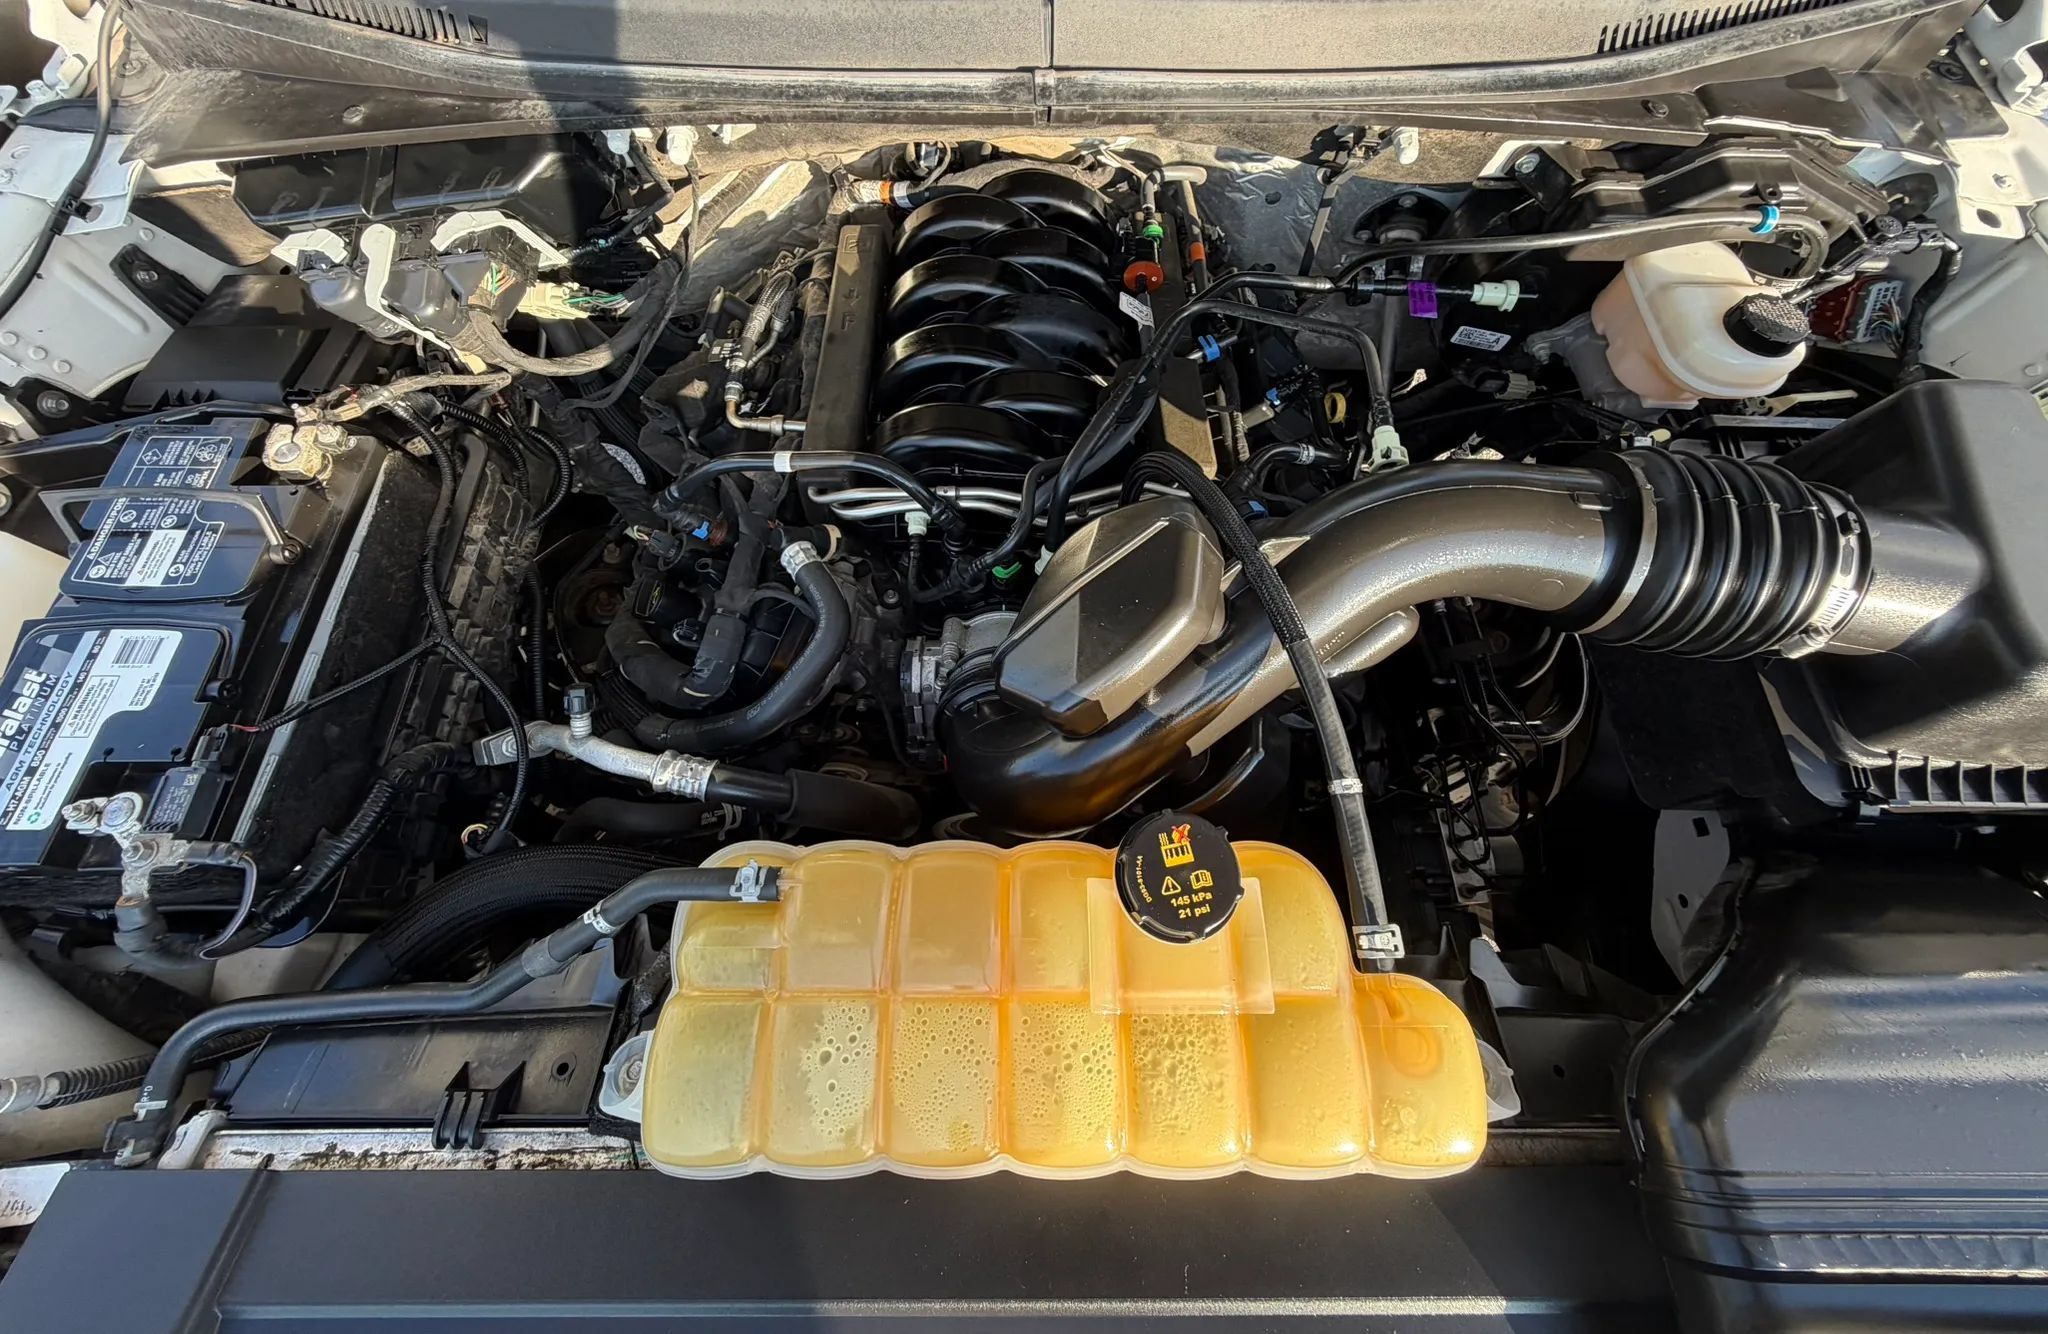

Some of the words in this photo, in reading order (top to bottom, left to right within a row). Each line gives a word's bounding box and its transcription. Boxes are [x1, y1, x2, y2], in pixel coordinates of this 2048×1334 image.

[0, 667, 47, 757] ralast
[6, 758, 27, 792] AGM
[23, 671, 73, 757] TECHNOLOGY
[7, 776, 33, 813] H7-AGM
[56, 707, 68, 724] 1000
[77, 671, 88, 684] 140
[10, 674, 57, 750] PLATINUM
[1171, 895, 1190, 907] 145
[1192, 891, 1213, 903] kPa
[1179, 907, 1191, 918] 21
[1195, 904, 1211, 917] psi
